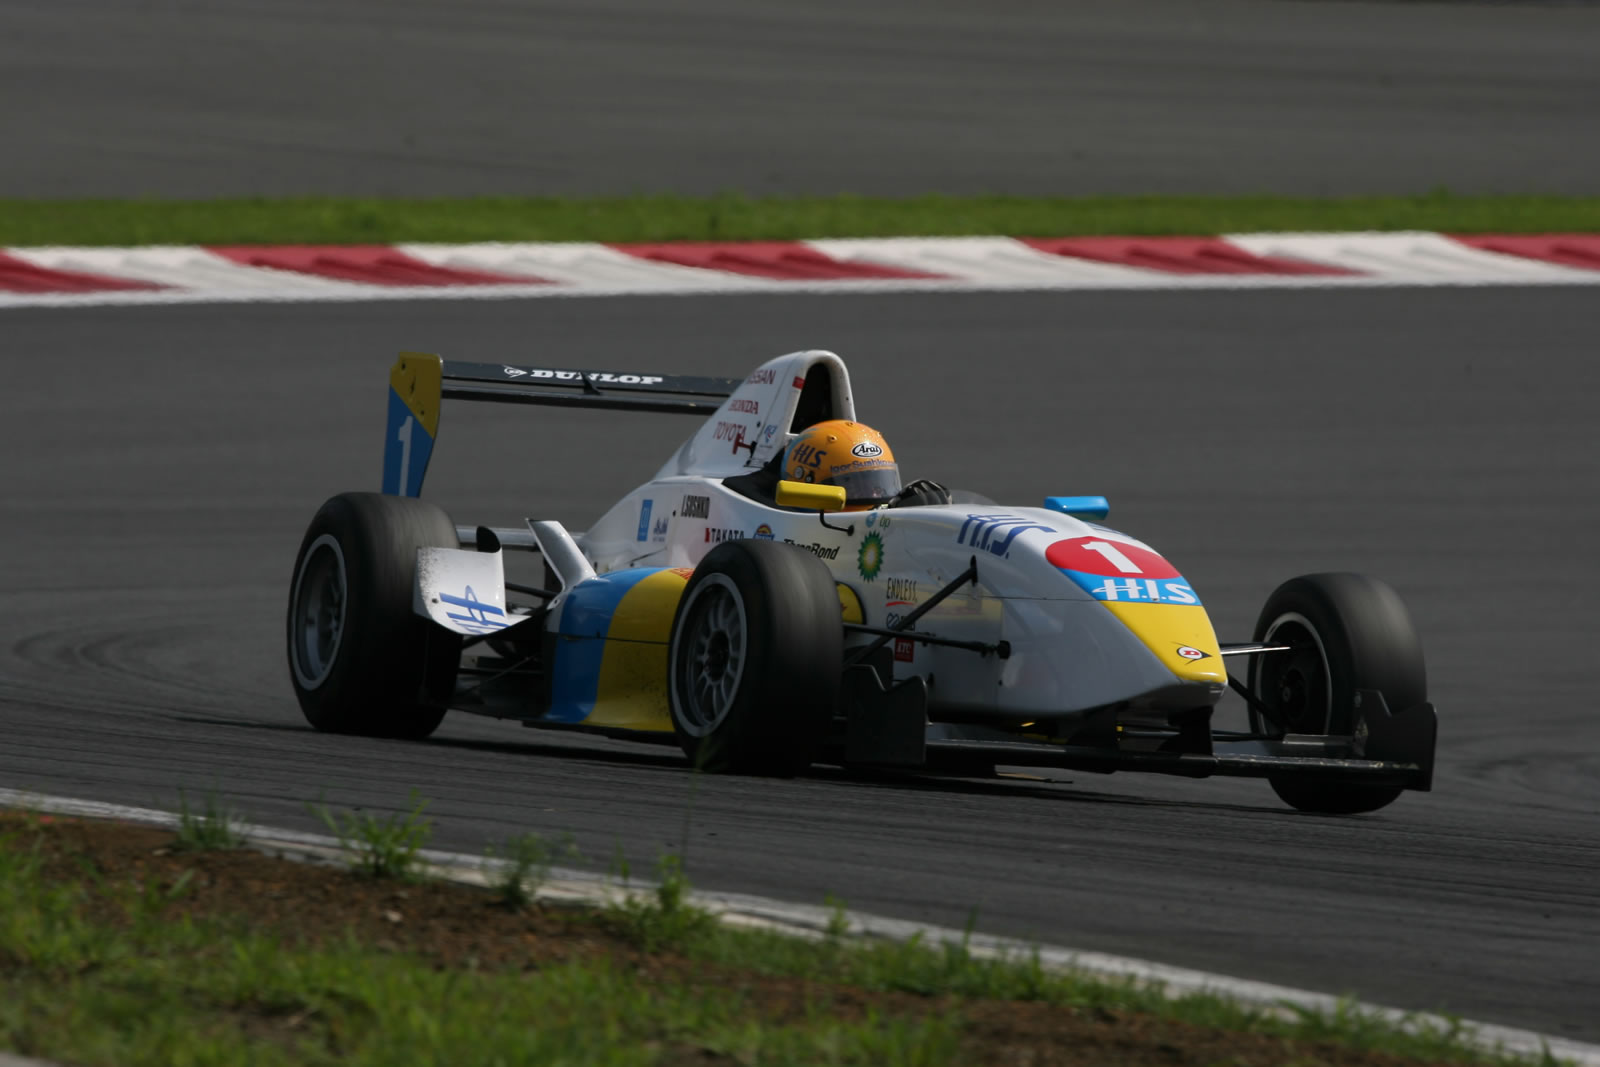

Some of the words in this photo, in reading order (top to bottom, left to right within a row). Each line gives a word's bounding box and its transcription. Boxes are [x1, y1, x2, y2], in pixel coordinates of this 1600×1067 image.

[530, 369, 663, 384] DUNLOP
[728, 400, 759, 415] HONDA
[712, 421, 747, 442] TOYOTA
[857, 444, 879, 454] Arai
[784, 538, 841, 561] TeBond
[1081, 541, 1144, 574] 1
